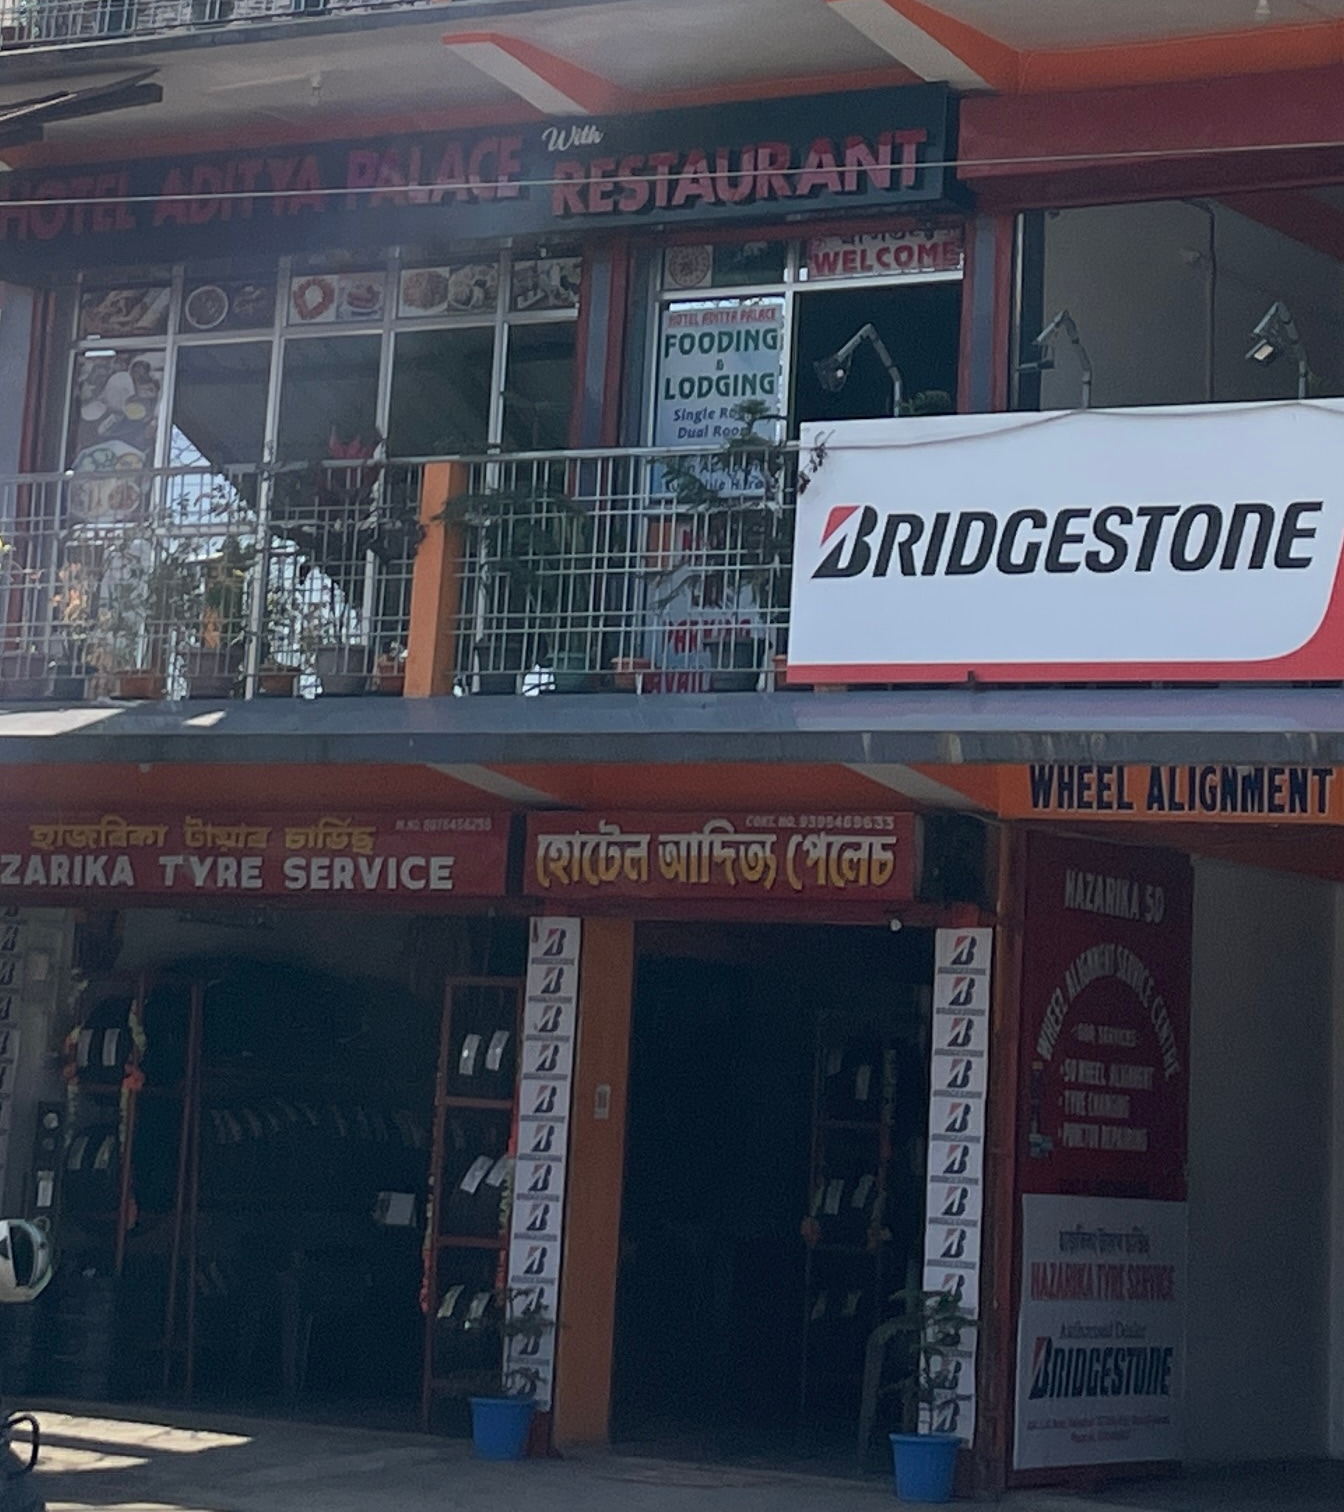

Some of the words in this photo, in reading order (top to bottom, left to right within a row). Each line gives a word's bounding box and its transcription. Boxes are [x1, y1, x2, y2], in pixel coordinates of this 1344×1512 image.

[542, 124, 604, 152] With
[155, 155, 326, 226] ADITYA
[347, 136, 523, 210] PALACE
[552, 128, 928, 217] RESTAURANT
[814, 240, 959, 276] WELCOME
[668, 312, 699, 328] HOTEL
[701, 309, 738, 325] ADITYA
[740, 308, 777, 323] PALACE
[664, 327, 778, 359] FOODING
[664, 372, 775, 400] LODGING
[673, 406, 716, 424] Single
[677, 425, 709, 439] Dual
[811, 500, 1324, 580] BRIDGESTONE
[1029, 764, 1132, 812] WHEEL
[1147, 764, 1336, 816] ALIGNMENT
[158, 854, 264, 889] TYRE
[283, 855, 456, 890] SERVICE
[535, 819, 651, 888] হোটেল
[658, 818, 779, 889] আদিত্য
[1064, 868, 1140, 920] HAZARIKA
[1027, 1336, 1174, 1400] BRIDGESTONE
